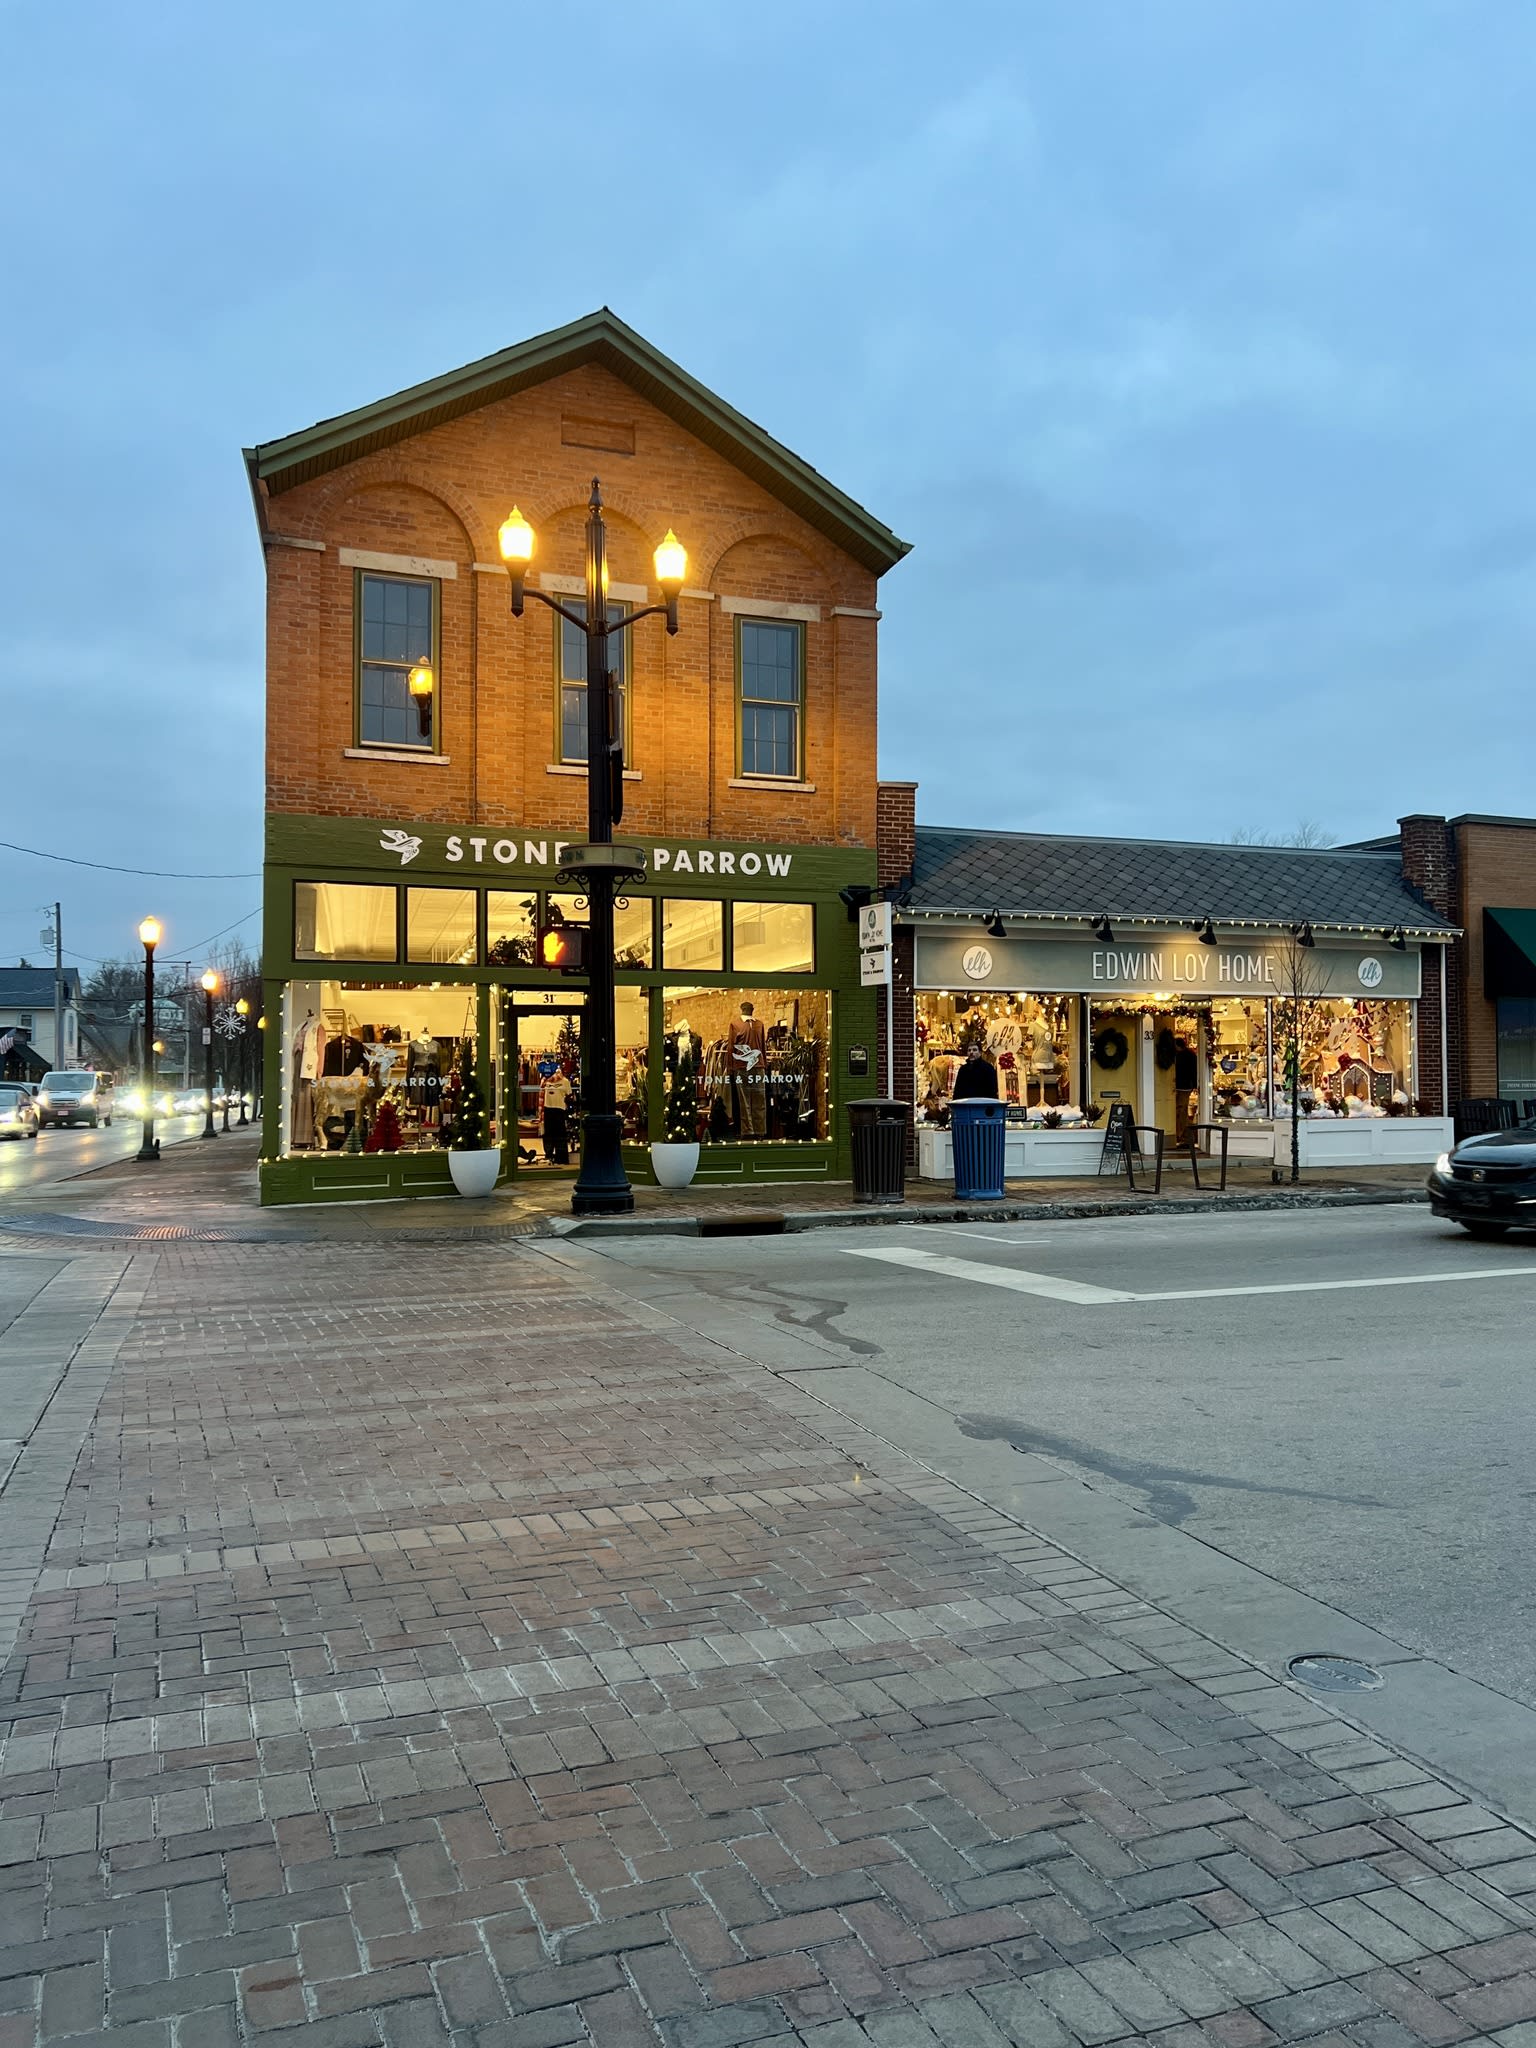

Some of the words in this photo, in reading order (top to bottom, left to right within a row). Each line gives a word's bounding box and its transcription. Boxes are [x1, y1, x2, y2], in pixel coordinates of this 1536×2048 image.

[643, 848, 793, 877] PARROW
[1092, 951, 1163, 981] EDWIN
[1173, 953, 1210, 983] LOY
[1218, 954, 1276, 983] HOME
[543, 993, 554, 1004] 31
[1144, 1030, 1155, 1041] 33
[366, 1078, 376, 1088] &
[735, 1074, 743, 1084] &
[747, 1074, 805, 1084] SPARROW
